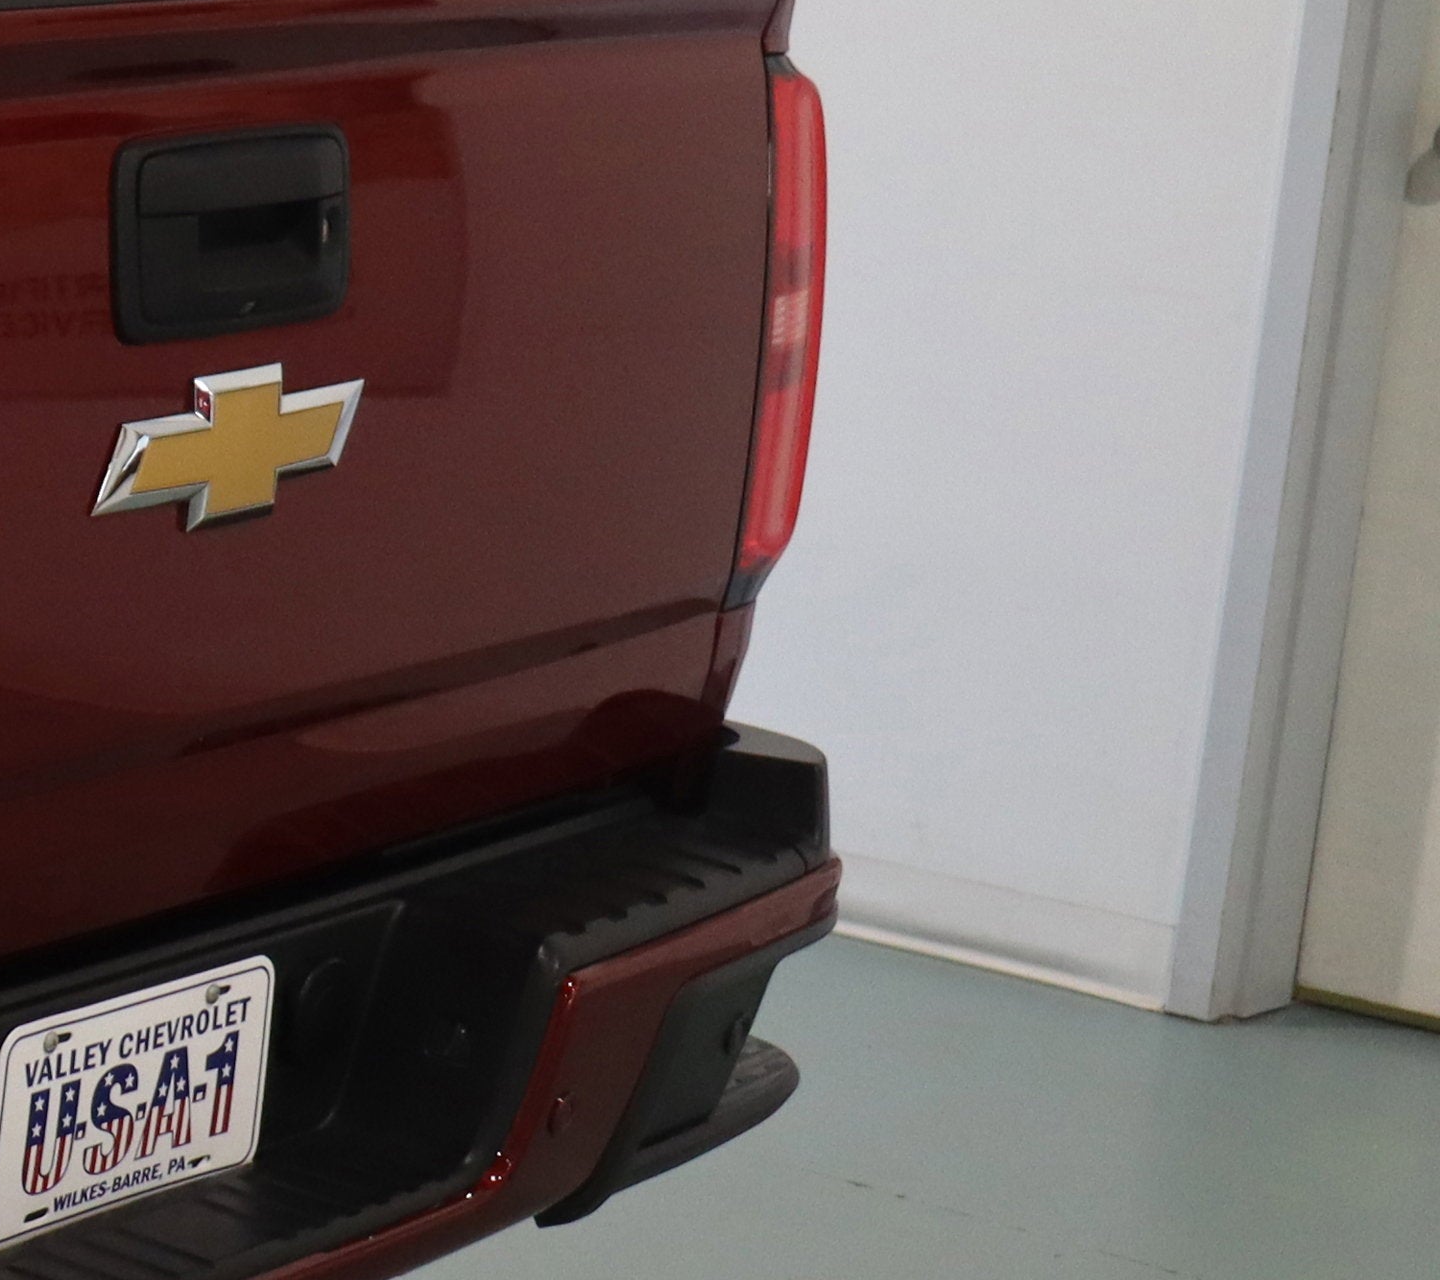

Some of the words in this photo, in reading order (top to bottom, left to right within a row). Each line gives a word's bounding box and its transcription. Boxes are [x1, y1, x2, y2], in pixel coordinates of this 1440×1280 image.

[25, 1038, 112, 1088] VALLEY
[119, 996, 252, 1060] CHEVROLET
[53, 1163, 163, 1213] WILKES-BARRE,
[167, 1156, 186, 1175] PA
